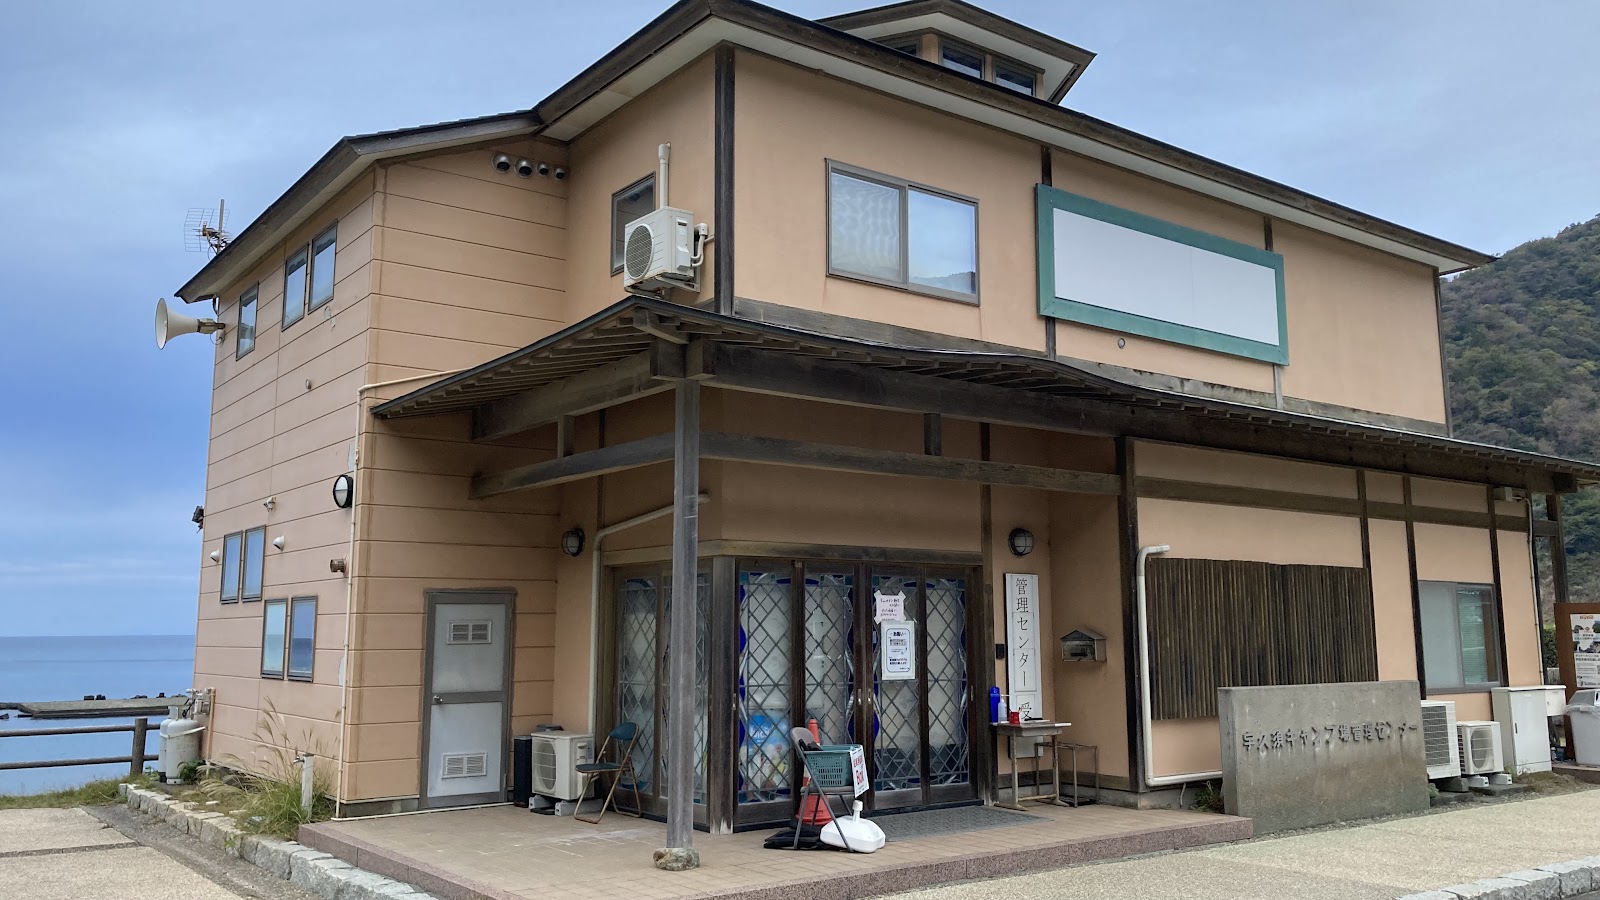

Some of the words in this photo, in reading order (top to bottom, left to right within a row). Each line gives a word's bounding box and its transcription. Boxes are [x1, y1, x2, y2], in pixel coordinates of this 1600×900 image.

[1015, 577, 1030, 687] 管理センター
